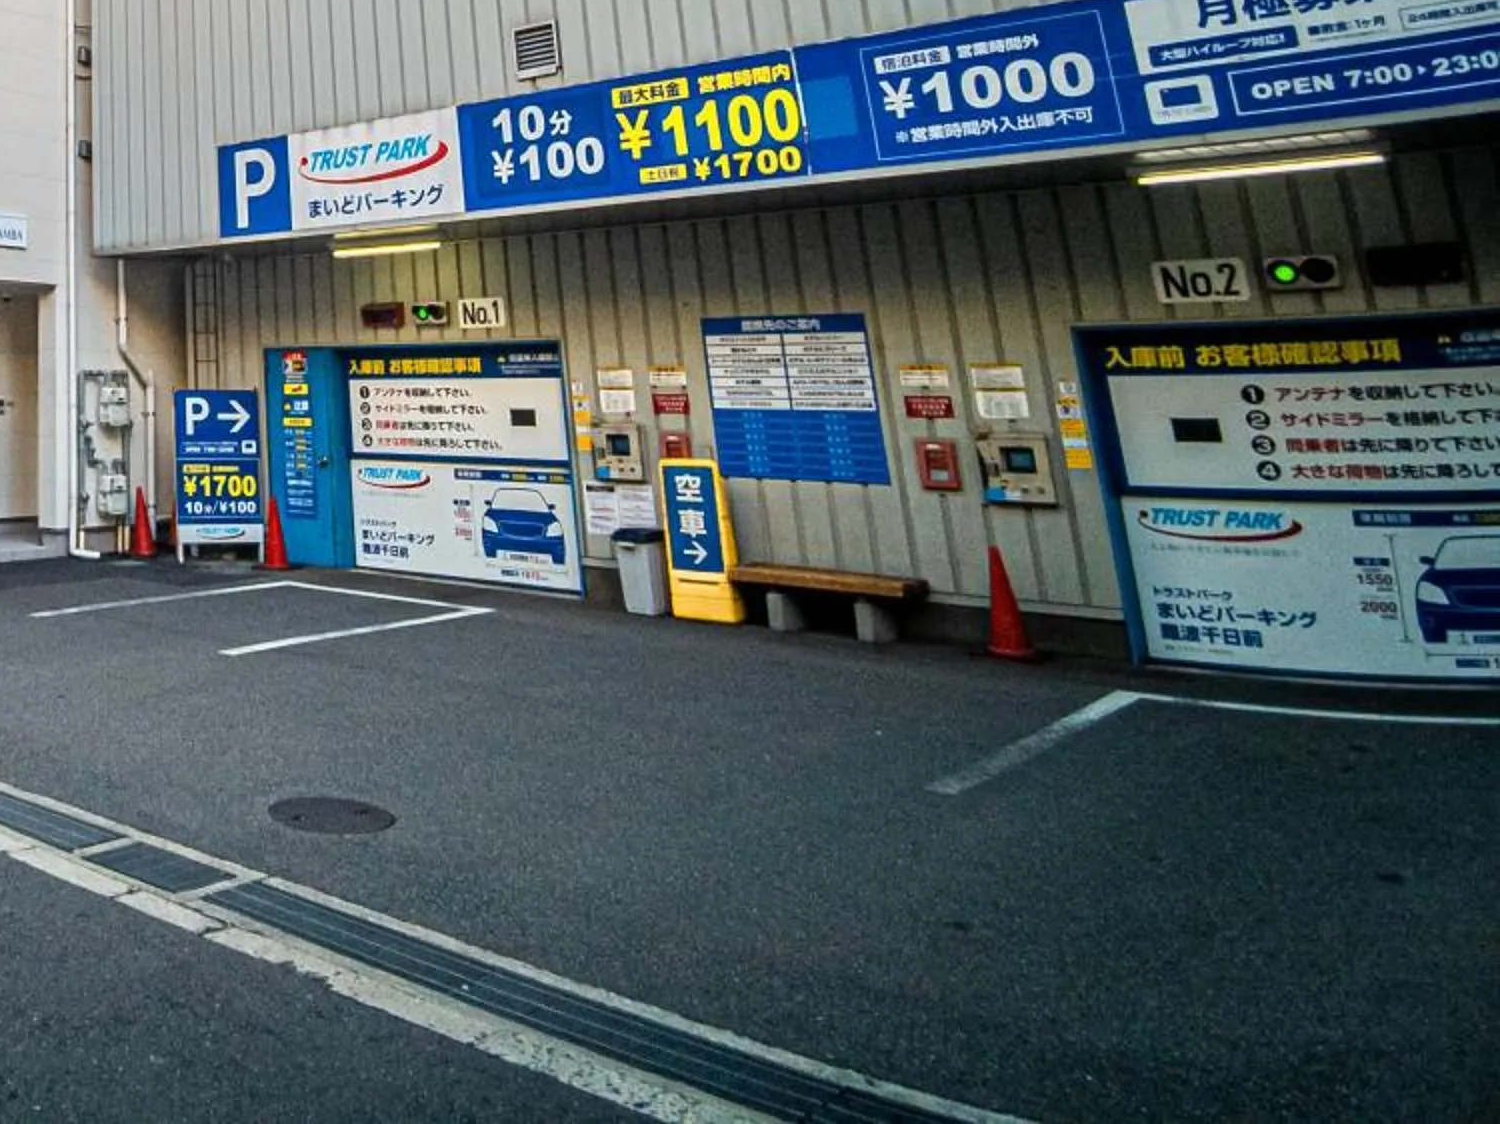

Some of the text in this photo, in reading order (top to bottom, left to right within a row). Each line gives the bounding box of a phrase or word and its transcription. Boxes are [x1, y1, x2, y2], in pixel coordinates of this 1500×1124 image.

[619, 82, 681, 104] 最大料金
[878, 52, 1095, 119] ¥1000
[1251, 49, 1500, 100] OPEN 7:00 23:0
[615, 88, 799, 160] ¥1100
[309, 133, 432, 172] TRUST PARK
[491, 136, 605, 185] ¥100
[234, 147, 276, 228] P
[1160, 263, 1242, 299] No.2
[463, 300, 503, 325] No.1
[185, 397, 210, 436] P
[183, 475, 257, 497] ¥1700
[674, 473, 708, 538] 空車
[1150, 507, 1286, 530] TRUST PARK
